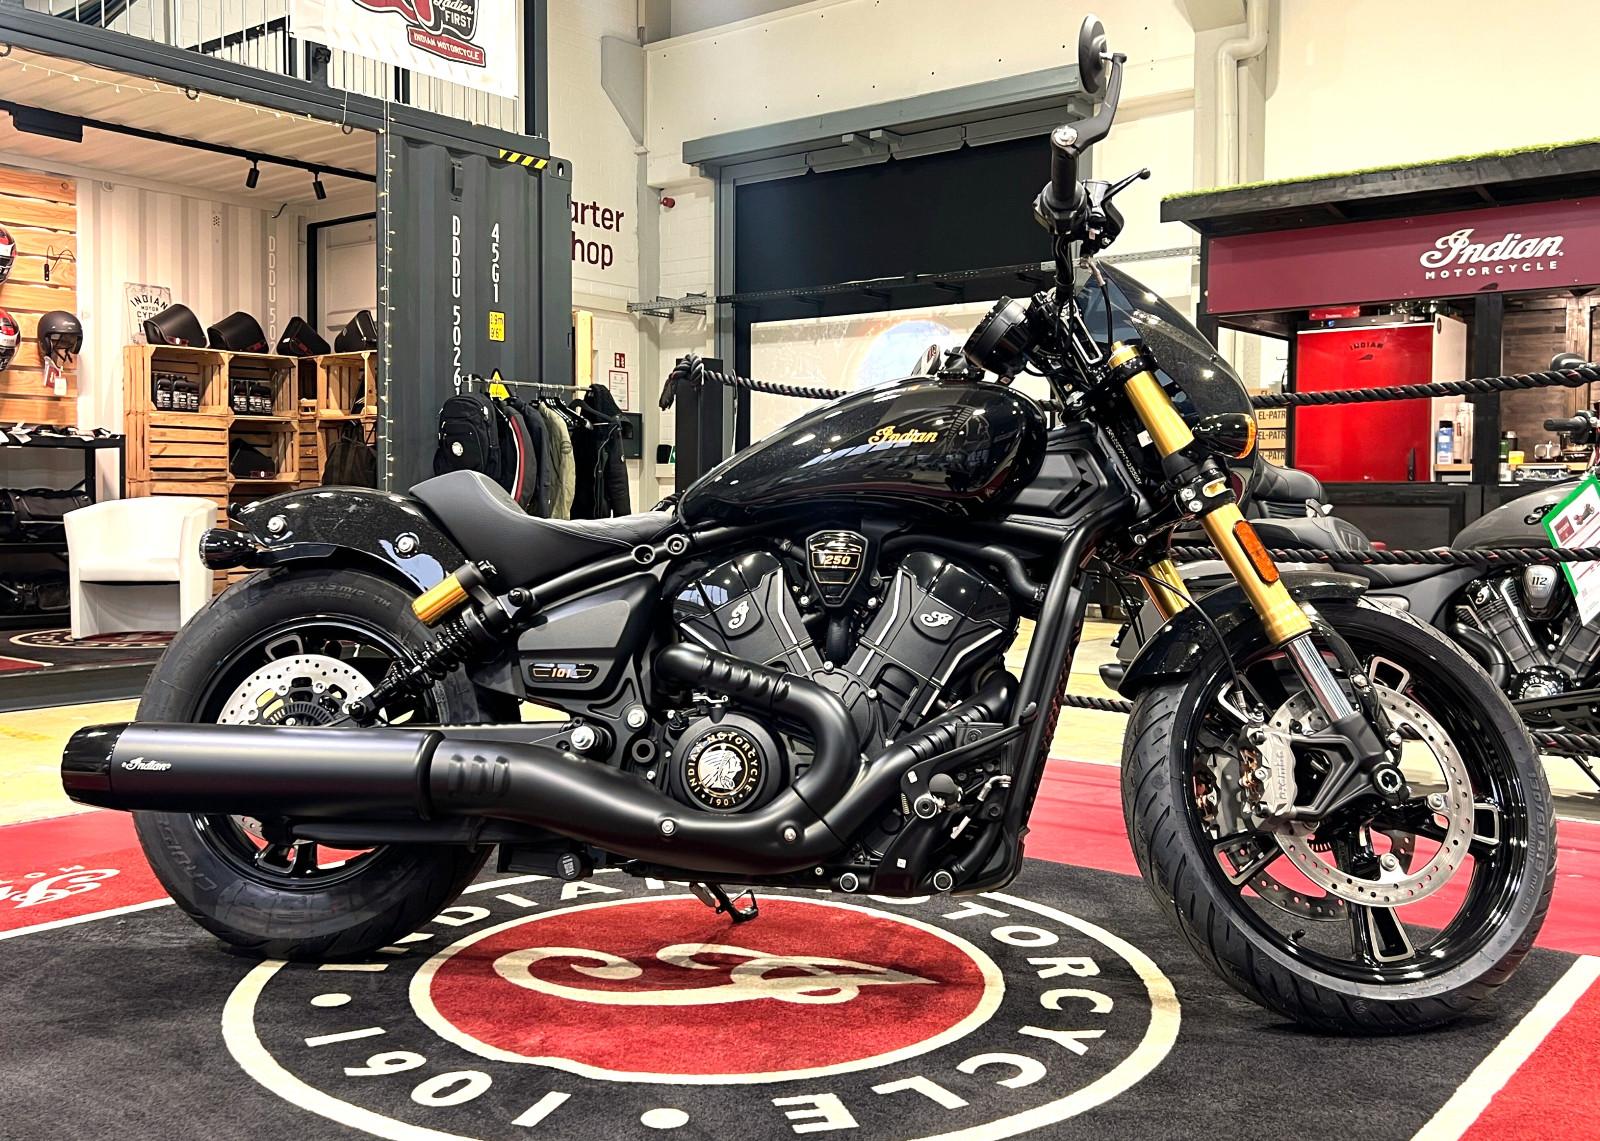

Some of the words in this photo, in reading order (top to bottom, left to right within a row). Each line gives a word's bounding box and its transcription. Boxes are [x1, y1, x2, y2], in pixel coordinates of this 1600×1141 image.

[445, 11, 473, 28] FIRST
[413, 32, 436, 46] INDIAN
[437, 40, 480, 60] MOTORCYCLE
[452, 215, 461, 298] DDDU
[571, 231, 613, 270] hop
[491, 223, 500, 303] 45G1
[1425, 261, 1557, 280] MOTORCYCLE
[130, 294, 168, 310] INDIAN
[1350, 342, 1384, 350] INDIAN
[868, 425, 938, 446] Indian
[1532, 576, 1548, 586] 112
[551, 667, 571, 679] 101
[121, 757, 172, 771] Indian
[706, 731, 759, 792] MOTORCYCLE
[709, 797, 736, 806] 1901
[304, 1026, 571, 1127] 1901
